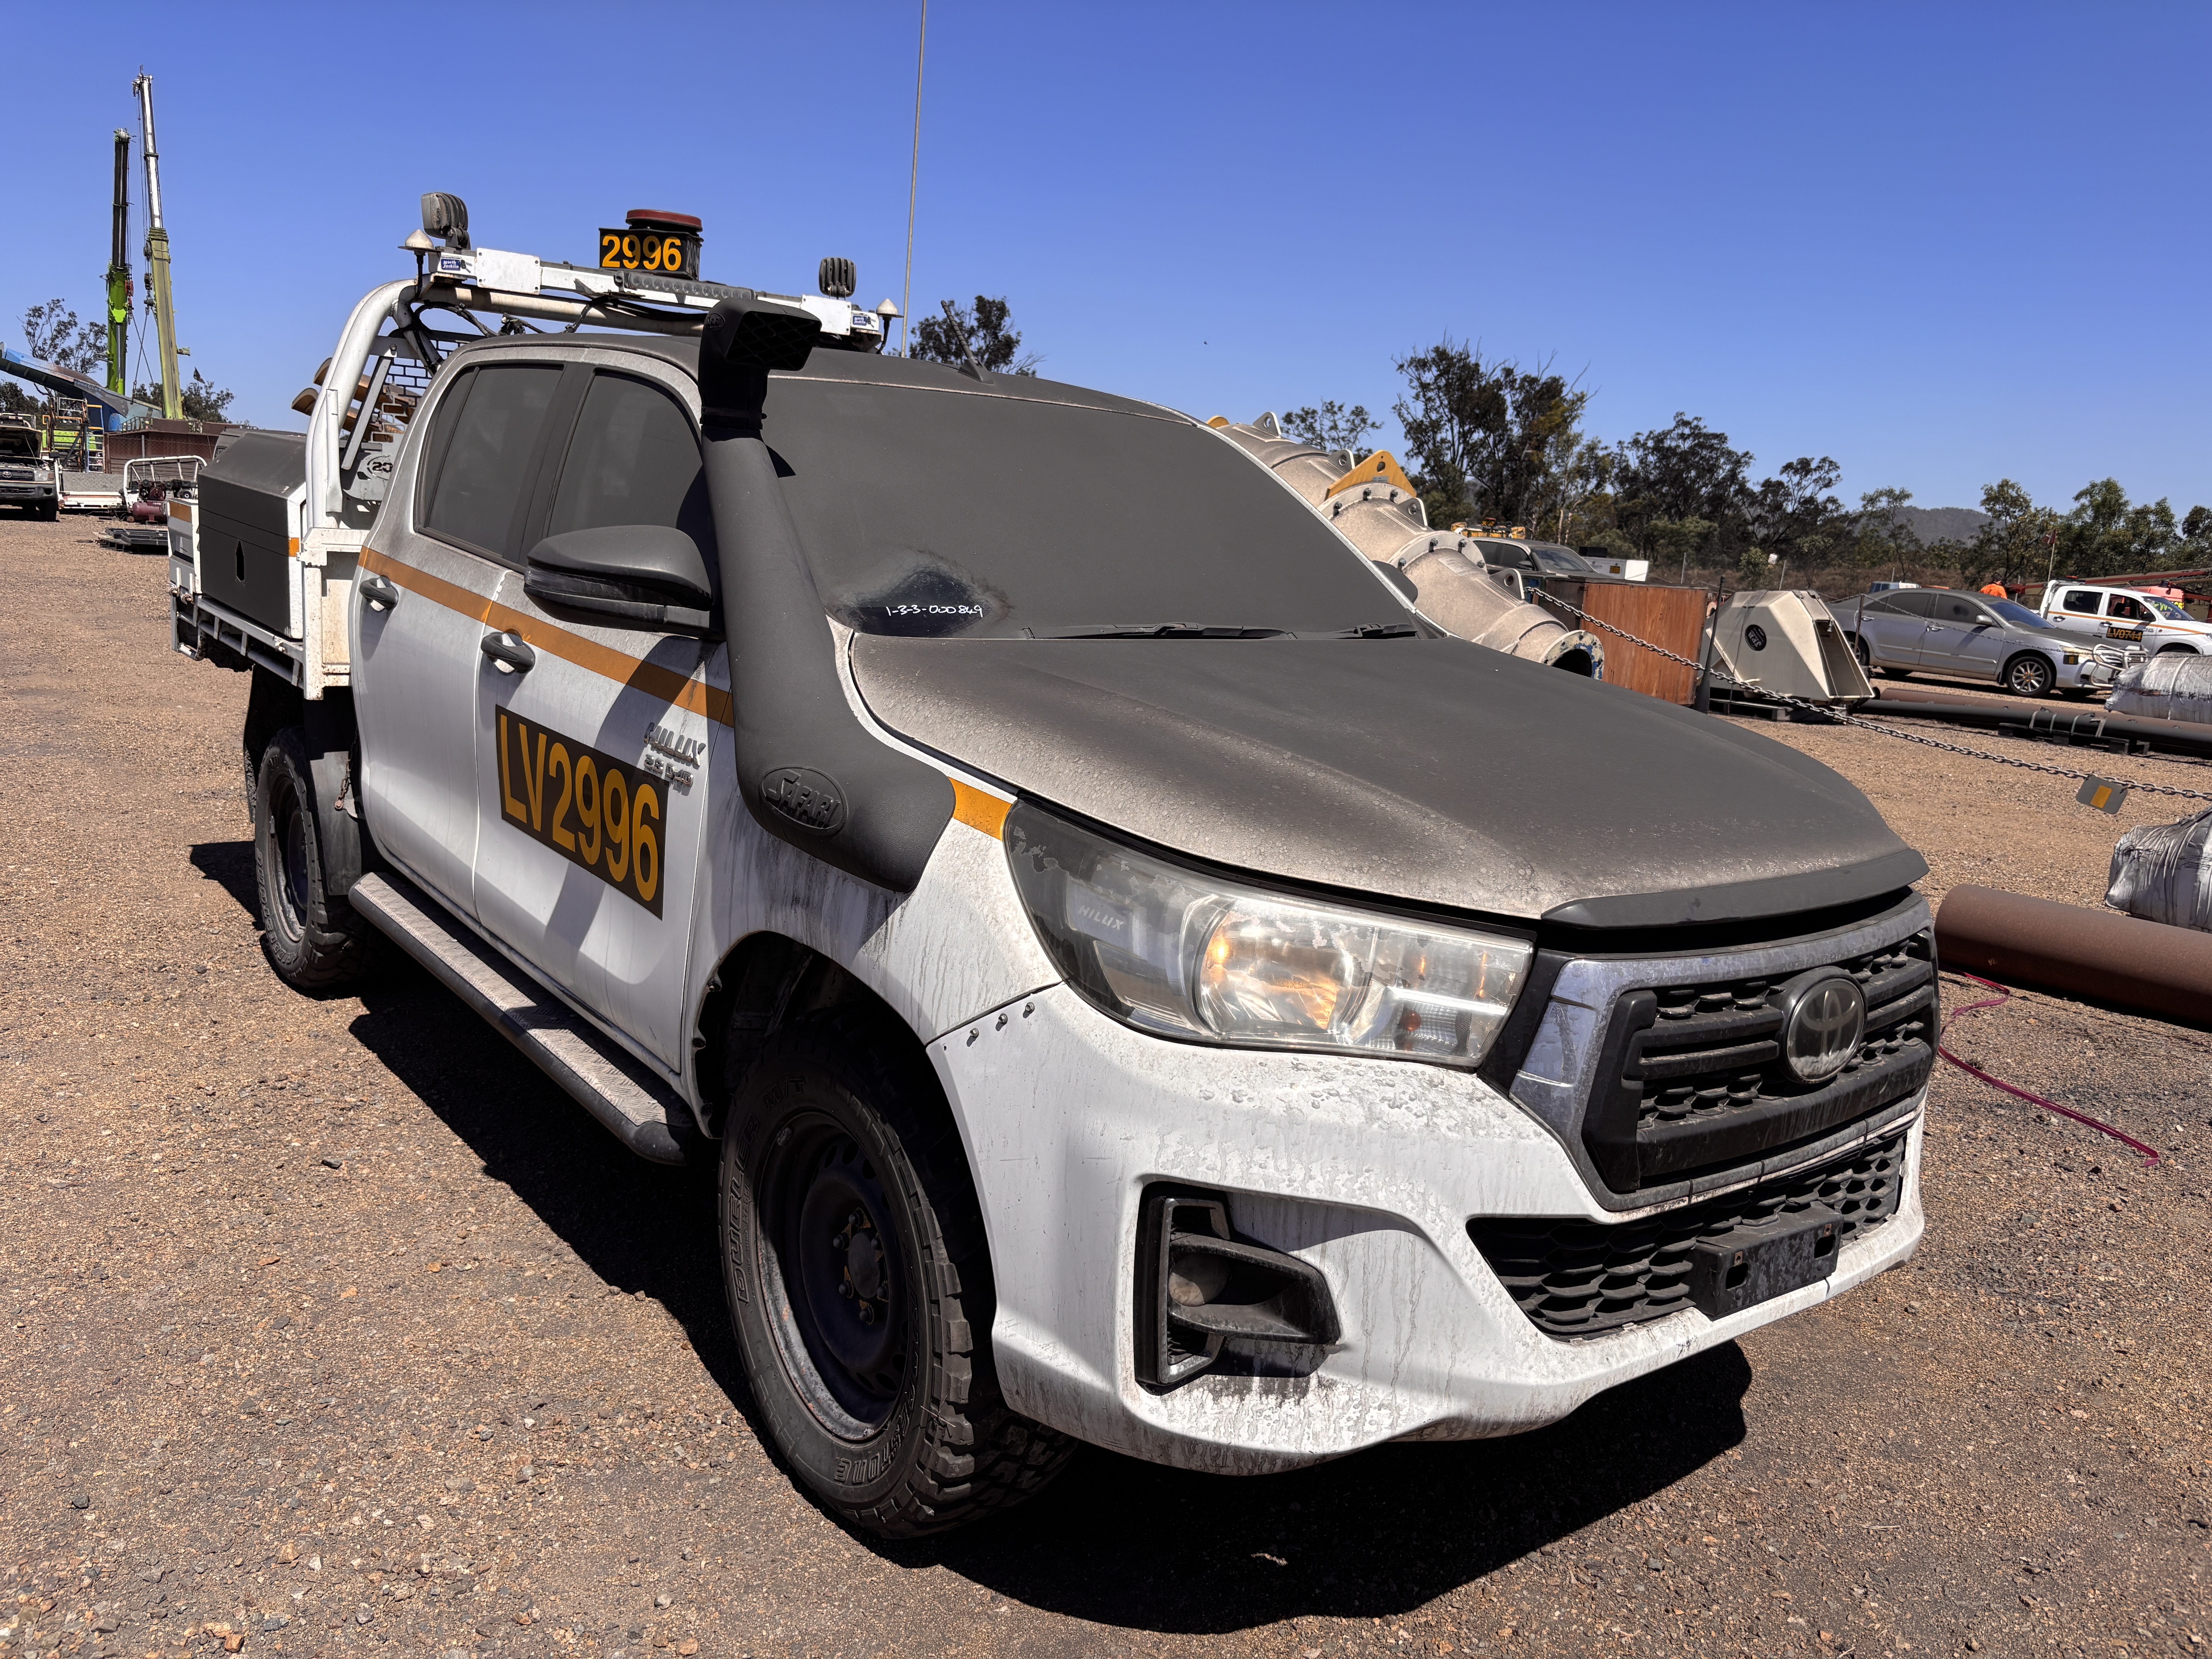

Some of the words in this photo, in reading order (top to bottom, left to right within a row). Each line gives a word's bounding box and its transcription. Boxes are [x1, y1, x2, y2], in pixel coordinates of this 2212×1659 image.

[602, 234, 682, 271] 2996
[644, 722, 706, 766] HILUX
[500, 714, 659, 902] LV2996
[766, 769, 842, 826] SAFARI
[1078, 905, 1125, 930] HILUX
